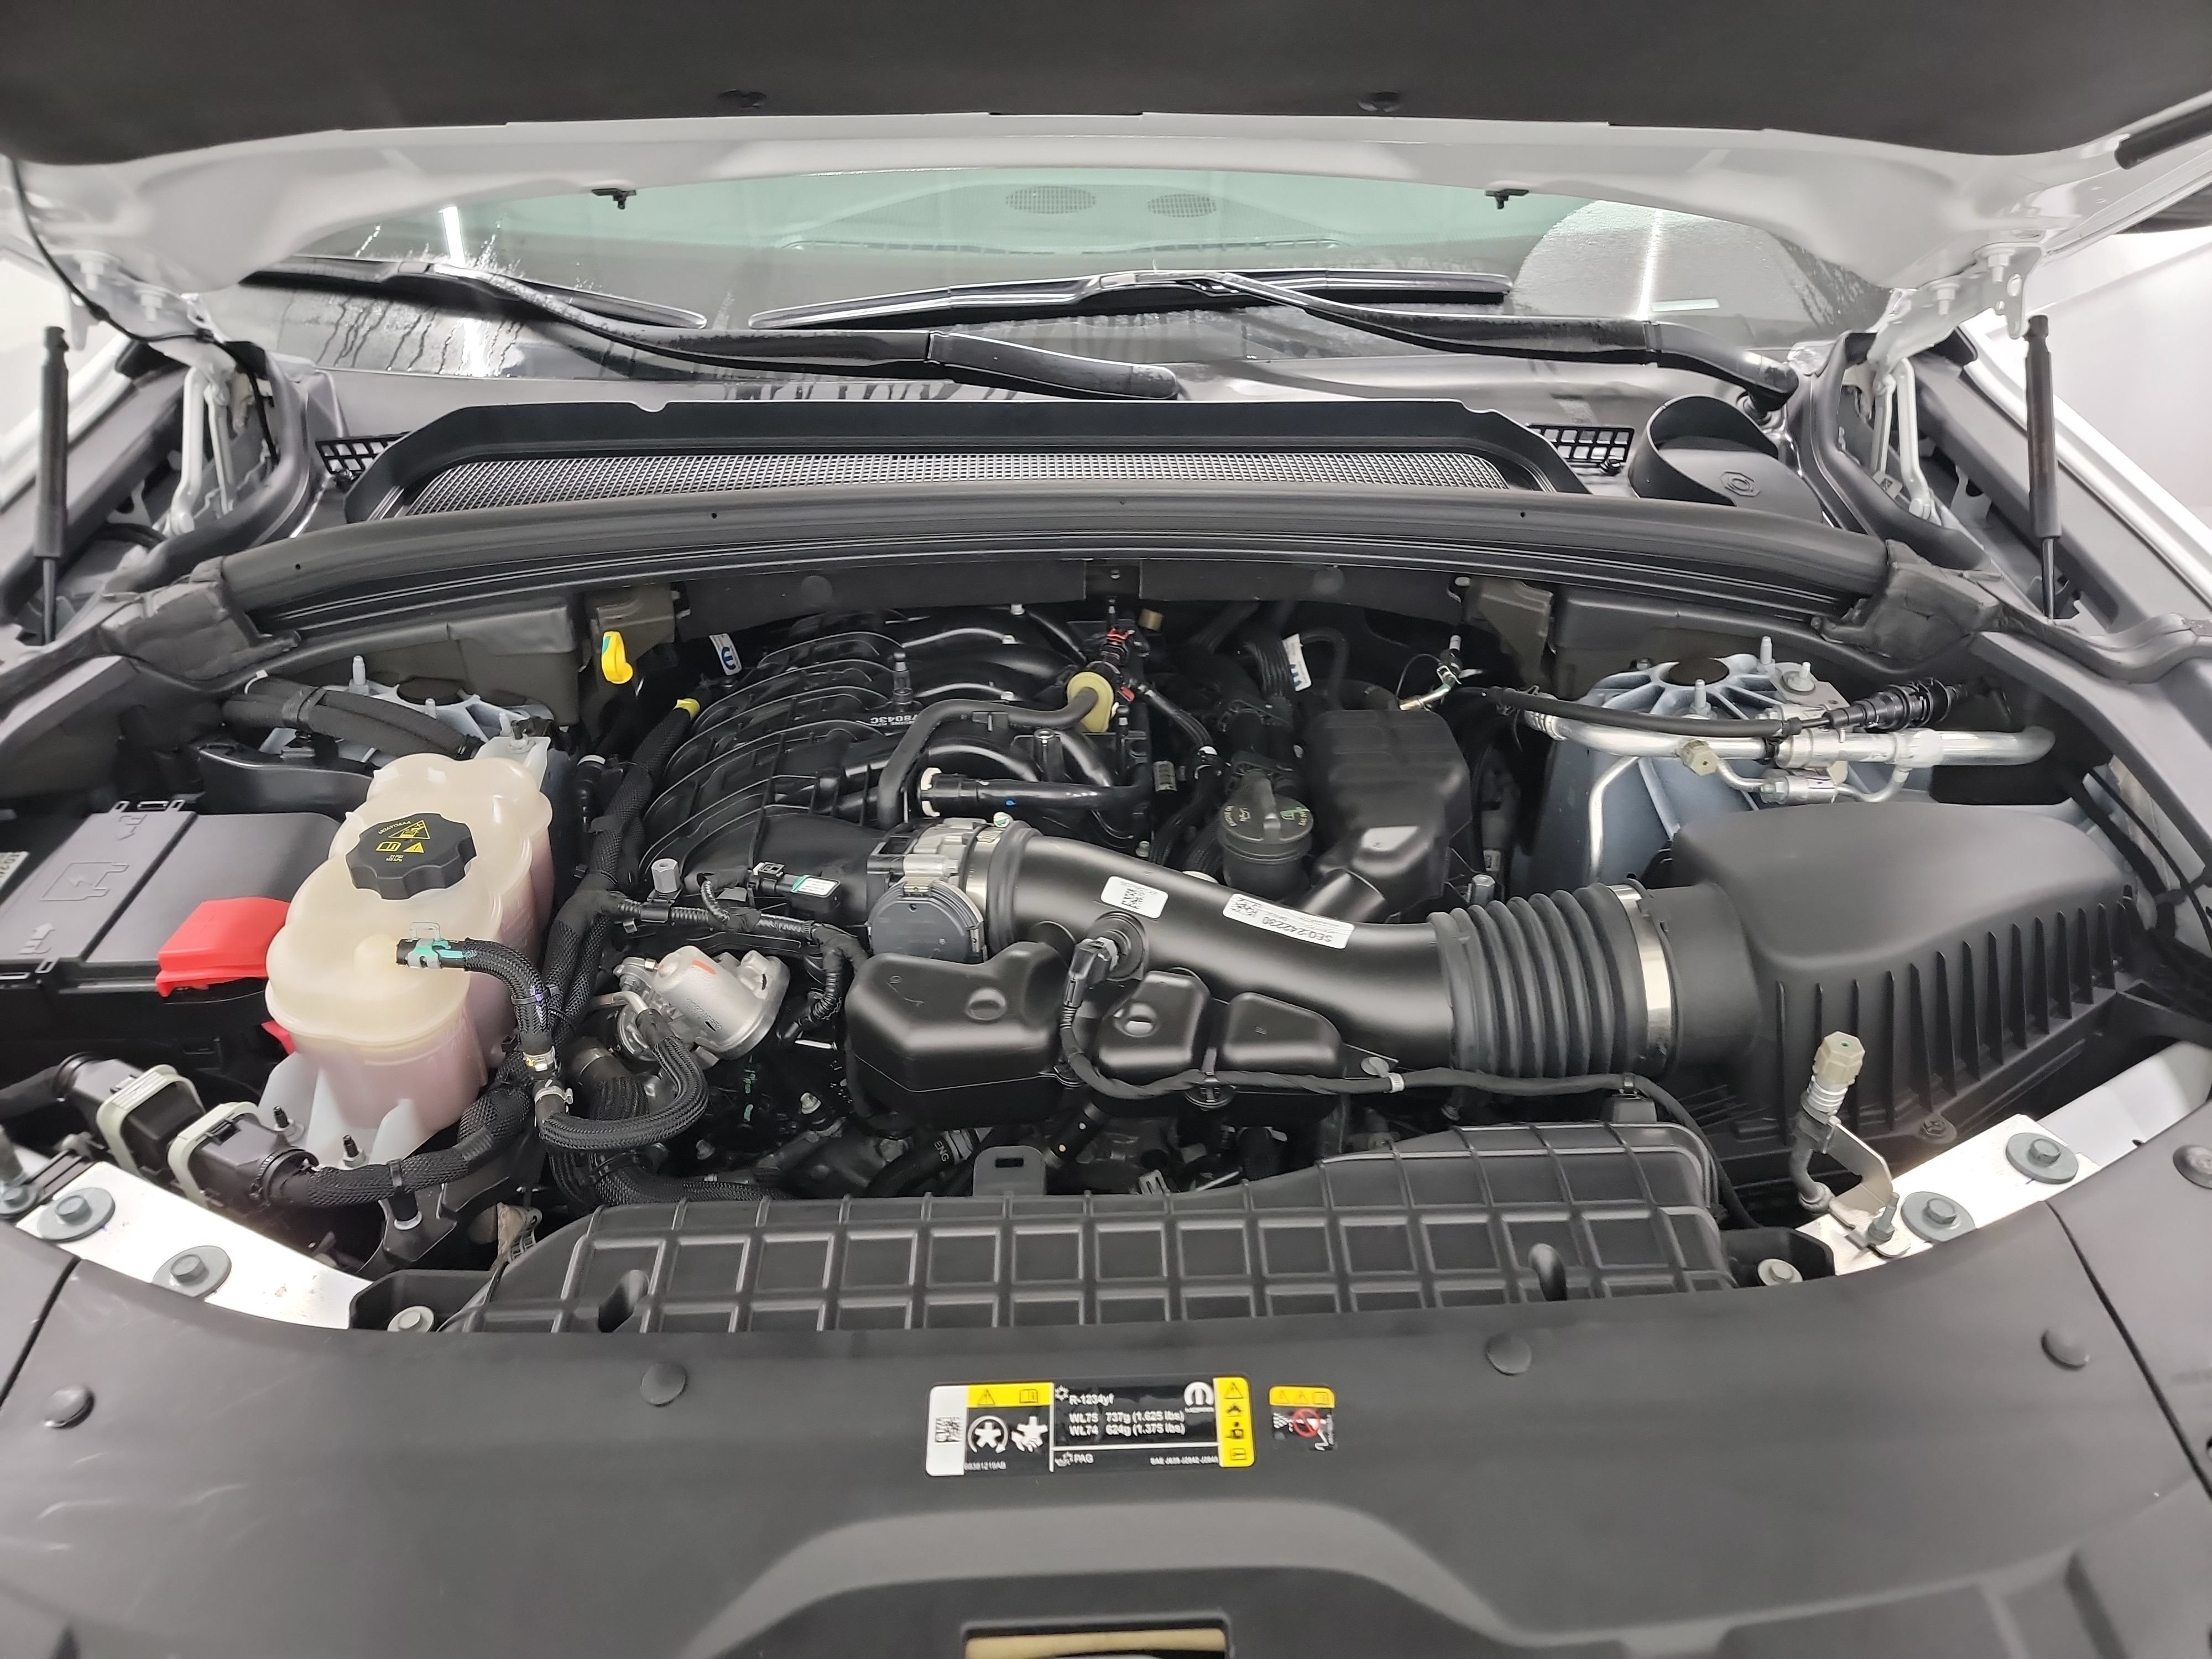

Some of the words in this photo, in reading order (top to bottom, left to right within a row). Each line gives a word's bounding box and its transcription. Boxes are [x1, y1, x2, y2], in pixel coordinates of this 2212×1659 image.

[933, 1140, 950, 1162] ENG
[1069, 1392, 1114, 1406] R-1234yf
[1069, 1412, 1099, 1424] WL75
[1105, 1411, 1131, 1424] 737g
[1132, 1410, 1164, 1423] (1.625
[1164, 1410, 1185, 1423] lbs)
[1069, 1423, 1099, 1436] WL74
[1105, 1423, 1131, 1437] 624g
[1132, 1423, 1164, 1437] (1.375
[1165, 1422, 1186, 1435] lbs)
[1074, 1454, 1094, 1464] PAG
